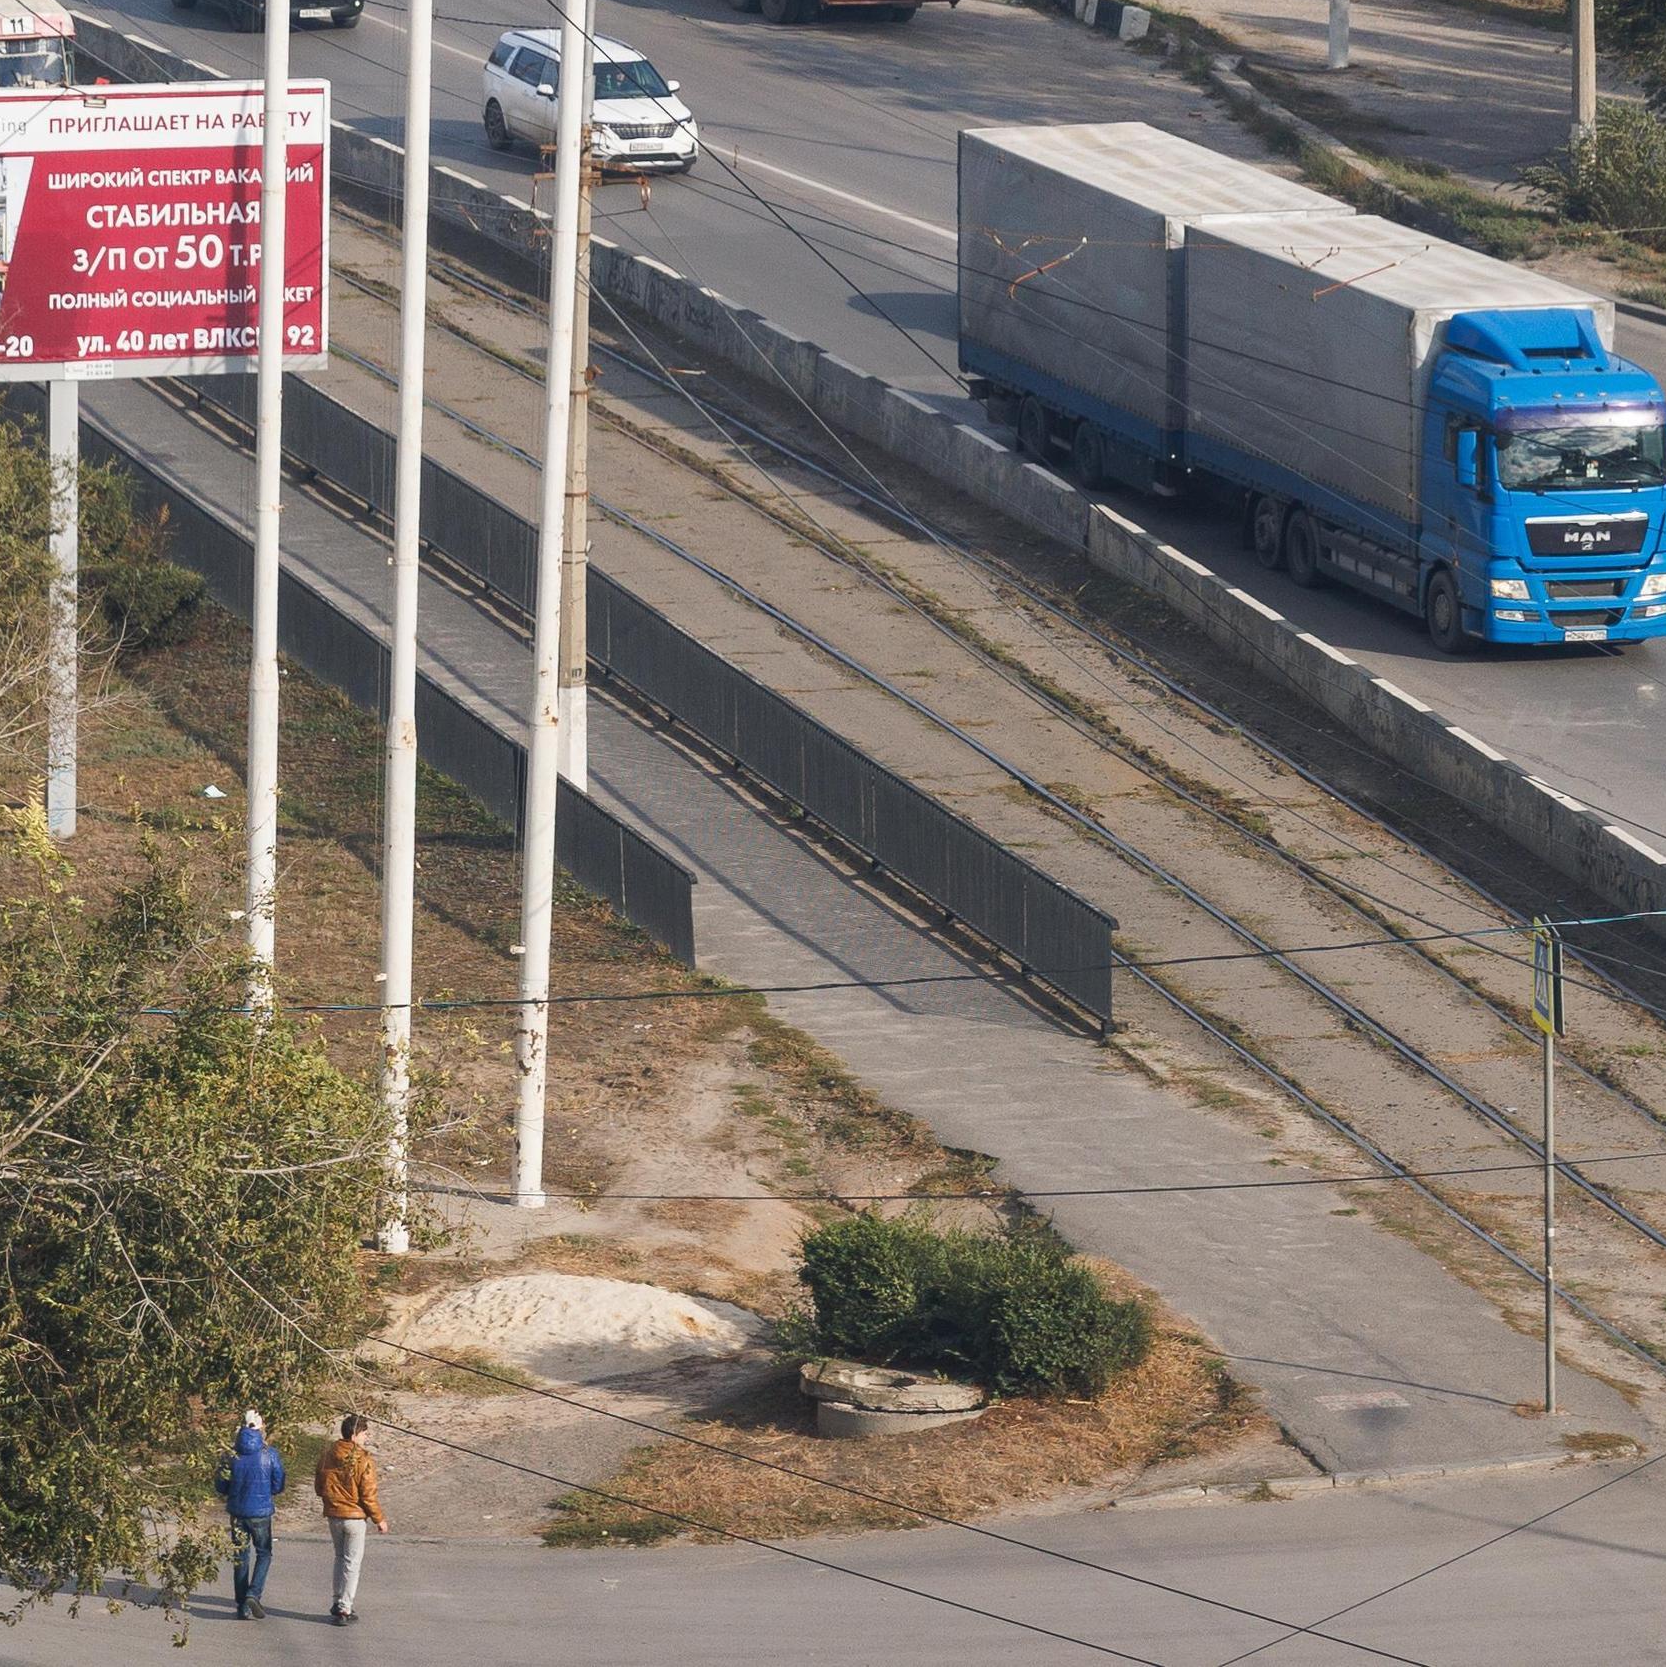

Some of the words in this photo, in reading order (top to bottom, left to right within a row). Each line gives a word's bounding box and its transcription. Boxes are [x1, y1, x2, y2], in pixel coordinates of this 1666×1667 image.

[10, 17, 24, 33] 11
[49, 114, 190, 133] ПРИГЛАШАЕТ
[196, 113, 225, 130] НА
[232, 110, 312, 129] РАБТУ
[48, 167, 144, 189] ШИРОКИЙ
[148, 169, 212, 187] СПЕКТР
[215, 163, 314, 185] ВАКАИЙ
[86, 201, 261, 229] СТАБИЛЬНАЯ
[72, 246, 127, 277] З/П
[133, 246, 169, 270] ОТ
[174, 234, 224, 270] 50
[48, 288, 128, 310] ПОЛНЫЙ
[131, 285, 256, 309] СОЦИАЛЬНЫЙ
[282, 286, 314, 302] КЕТ
[77, 335, 111, 357] ул.
[116, 331, 144, 351] 40
[148, 333, 189, 350] лет
[287, 325, 315, 346] 92
[1564, 530, 1611, 543] MAN
